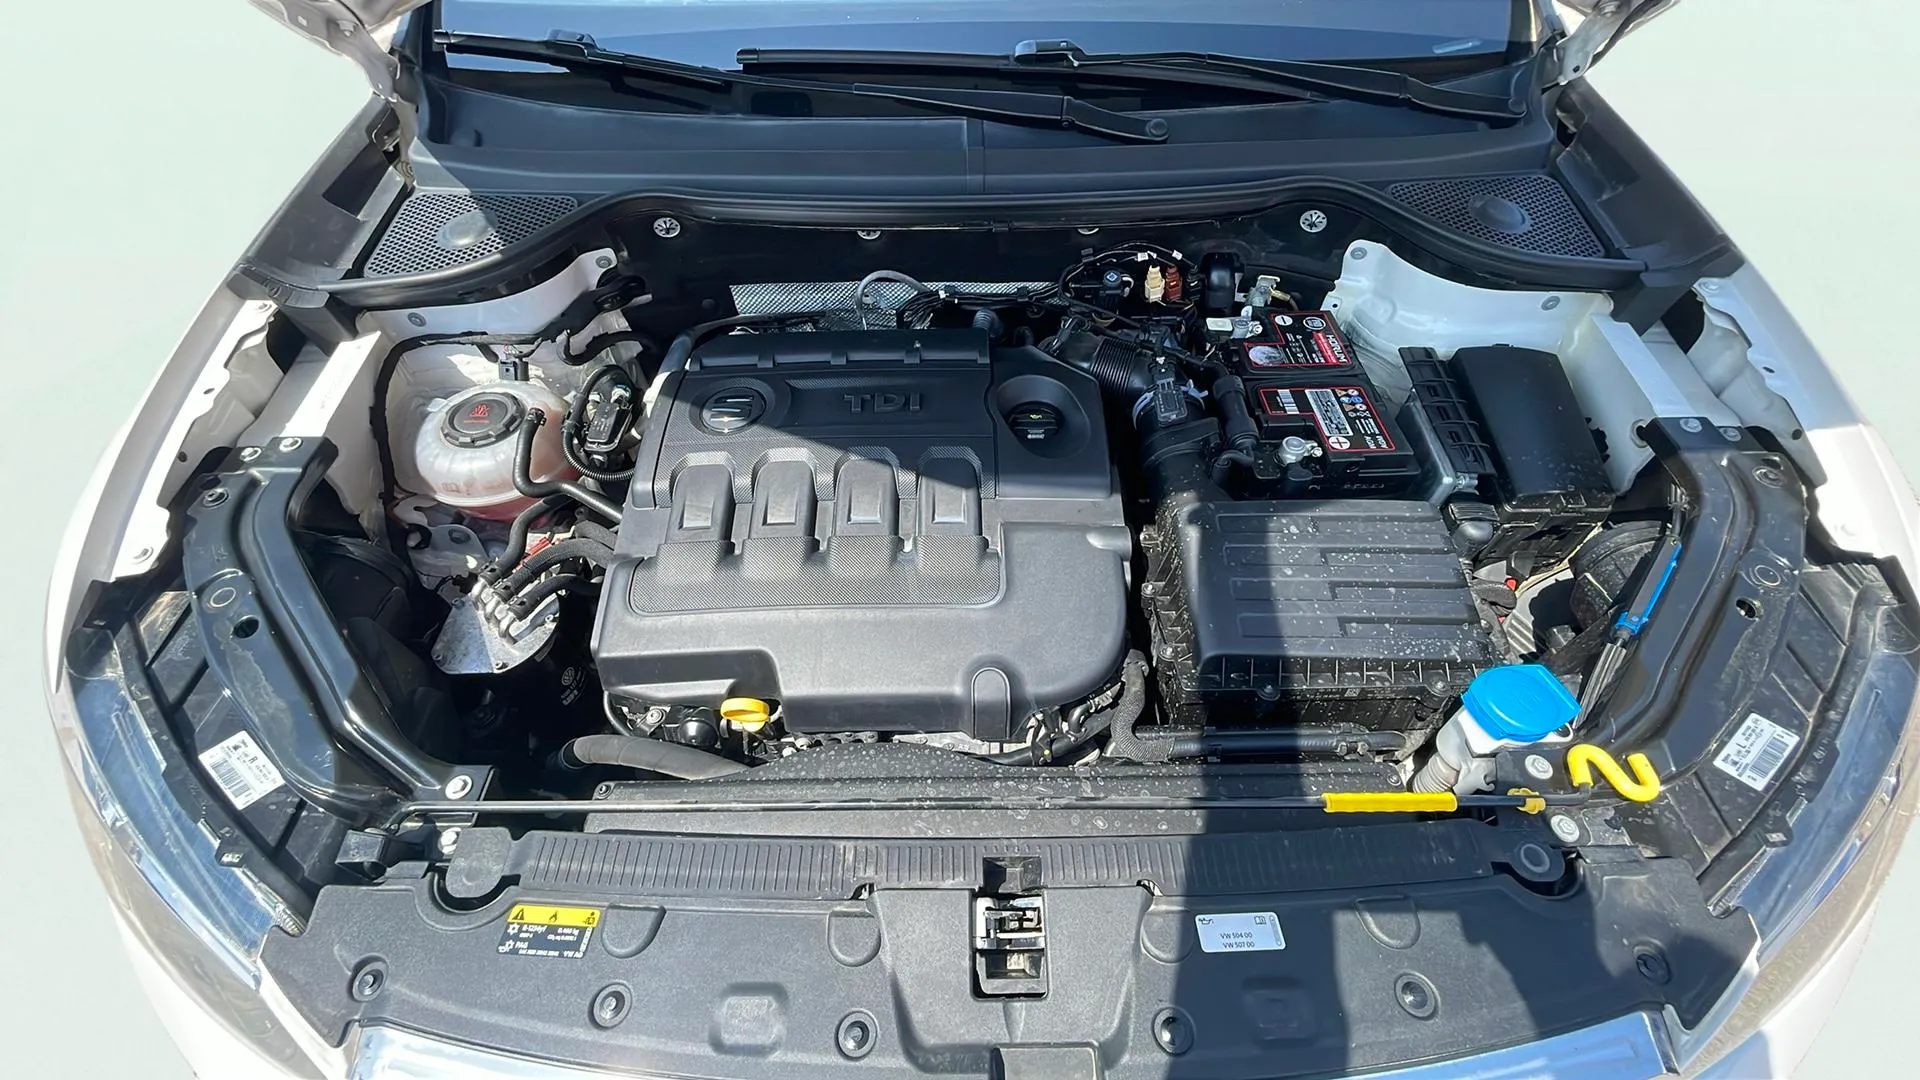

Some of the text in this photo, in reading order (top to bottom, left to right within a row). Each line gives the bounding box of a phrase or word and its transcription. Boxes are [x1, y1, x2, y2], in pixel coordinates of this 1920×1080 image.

[1326, 334, 1348, 363] HORUM
[844, 392, 921, 413] TDI
[1220, 932, 1231, 940] VW
[1244, 931, 1253, 939] 00
